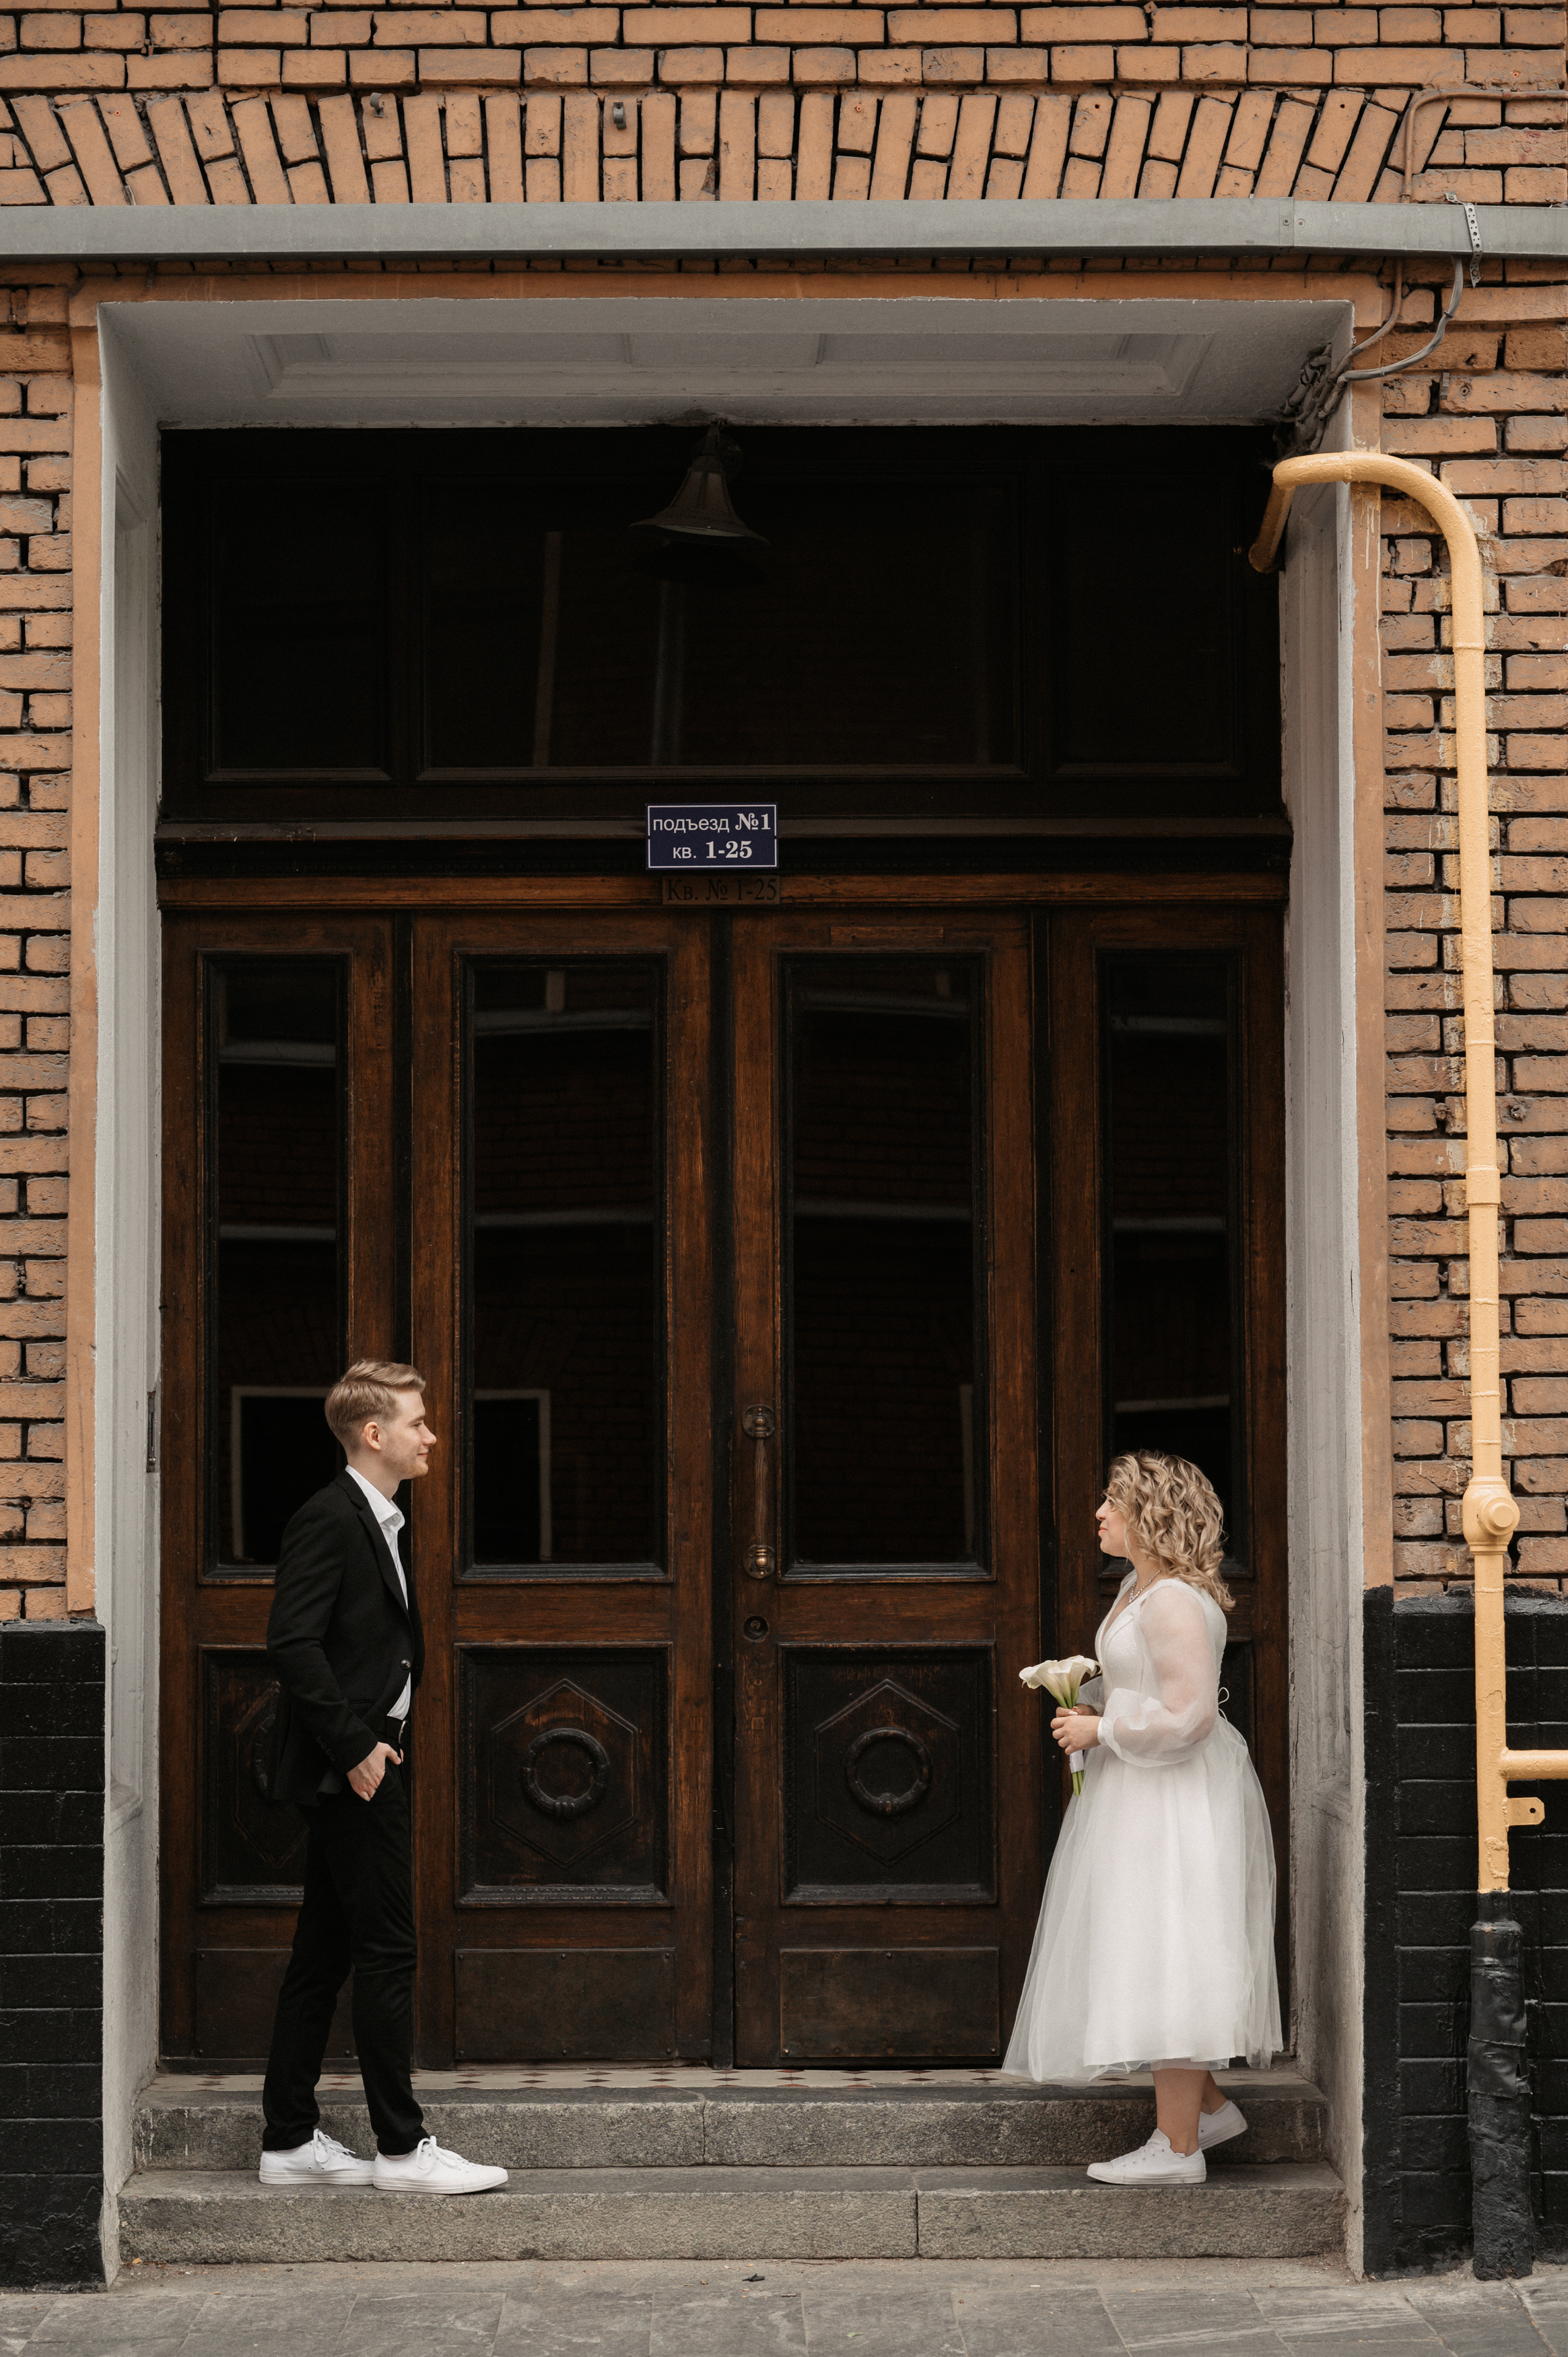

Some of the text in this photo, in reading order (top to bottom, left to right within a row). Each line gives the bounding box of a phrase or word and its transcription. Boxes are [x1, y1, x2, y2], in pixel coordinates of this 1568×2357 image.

[653, 813, 771, 833] подъезд №1
[673, 840, 752, 859] кв. 1-25
[667, 878, 776, 901] Кв. № 1-25
